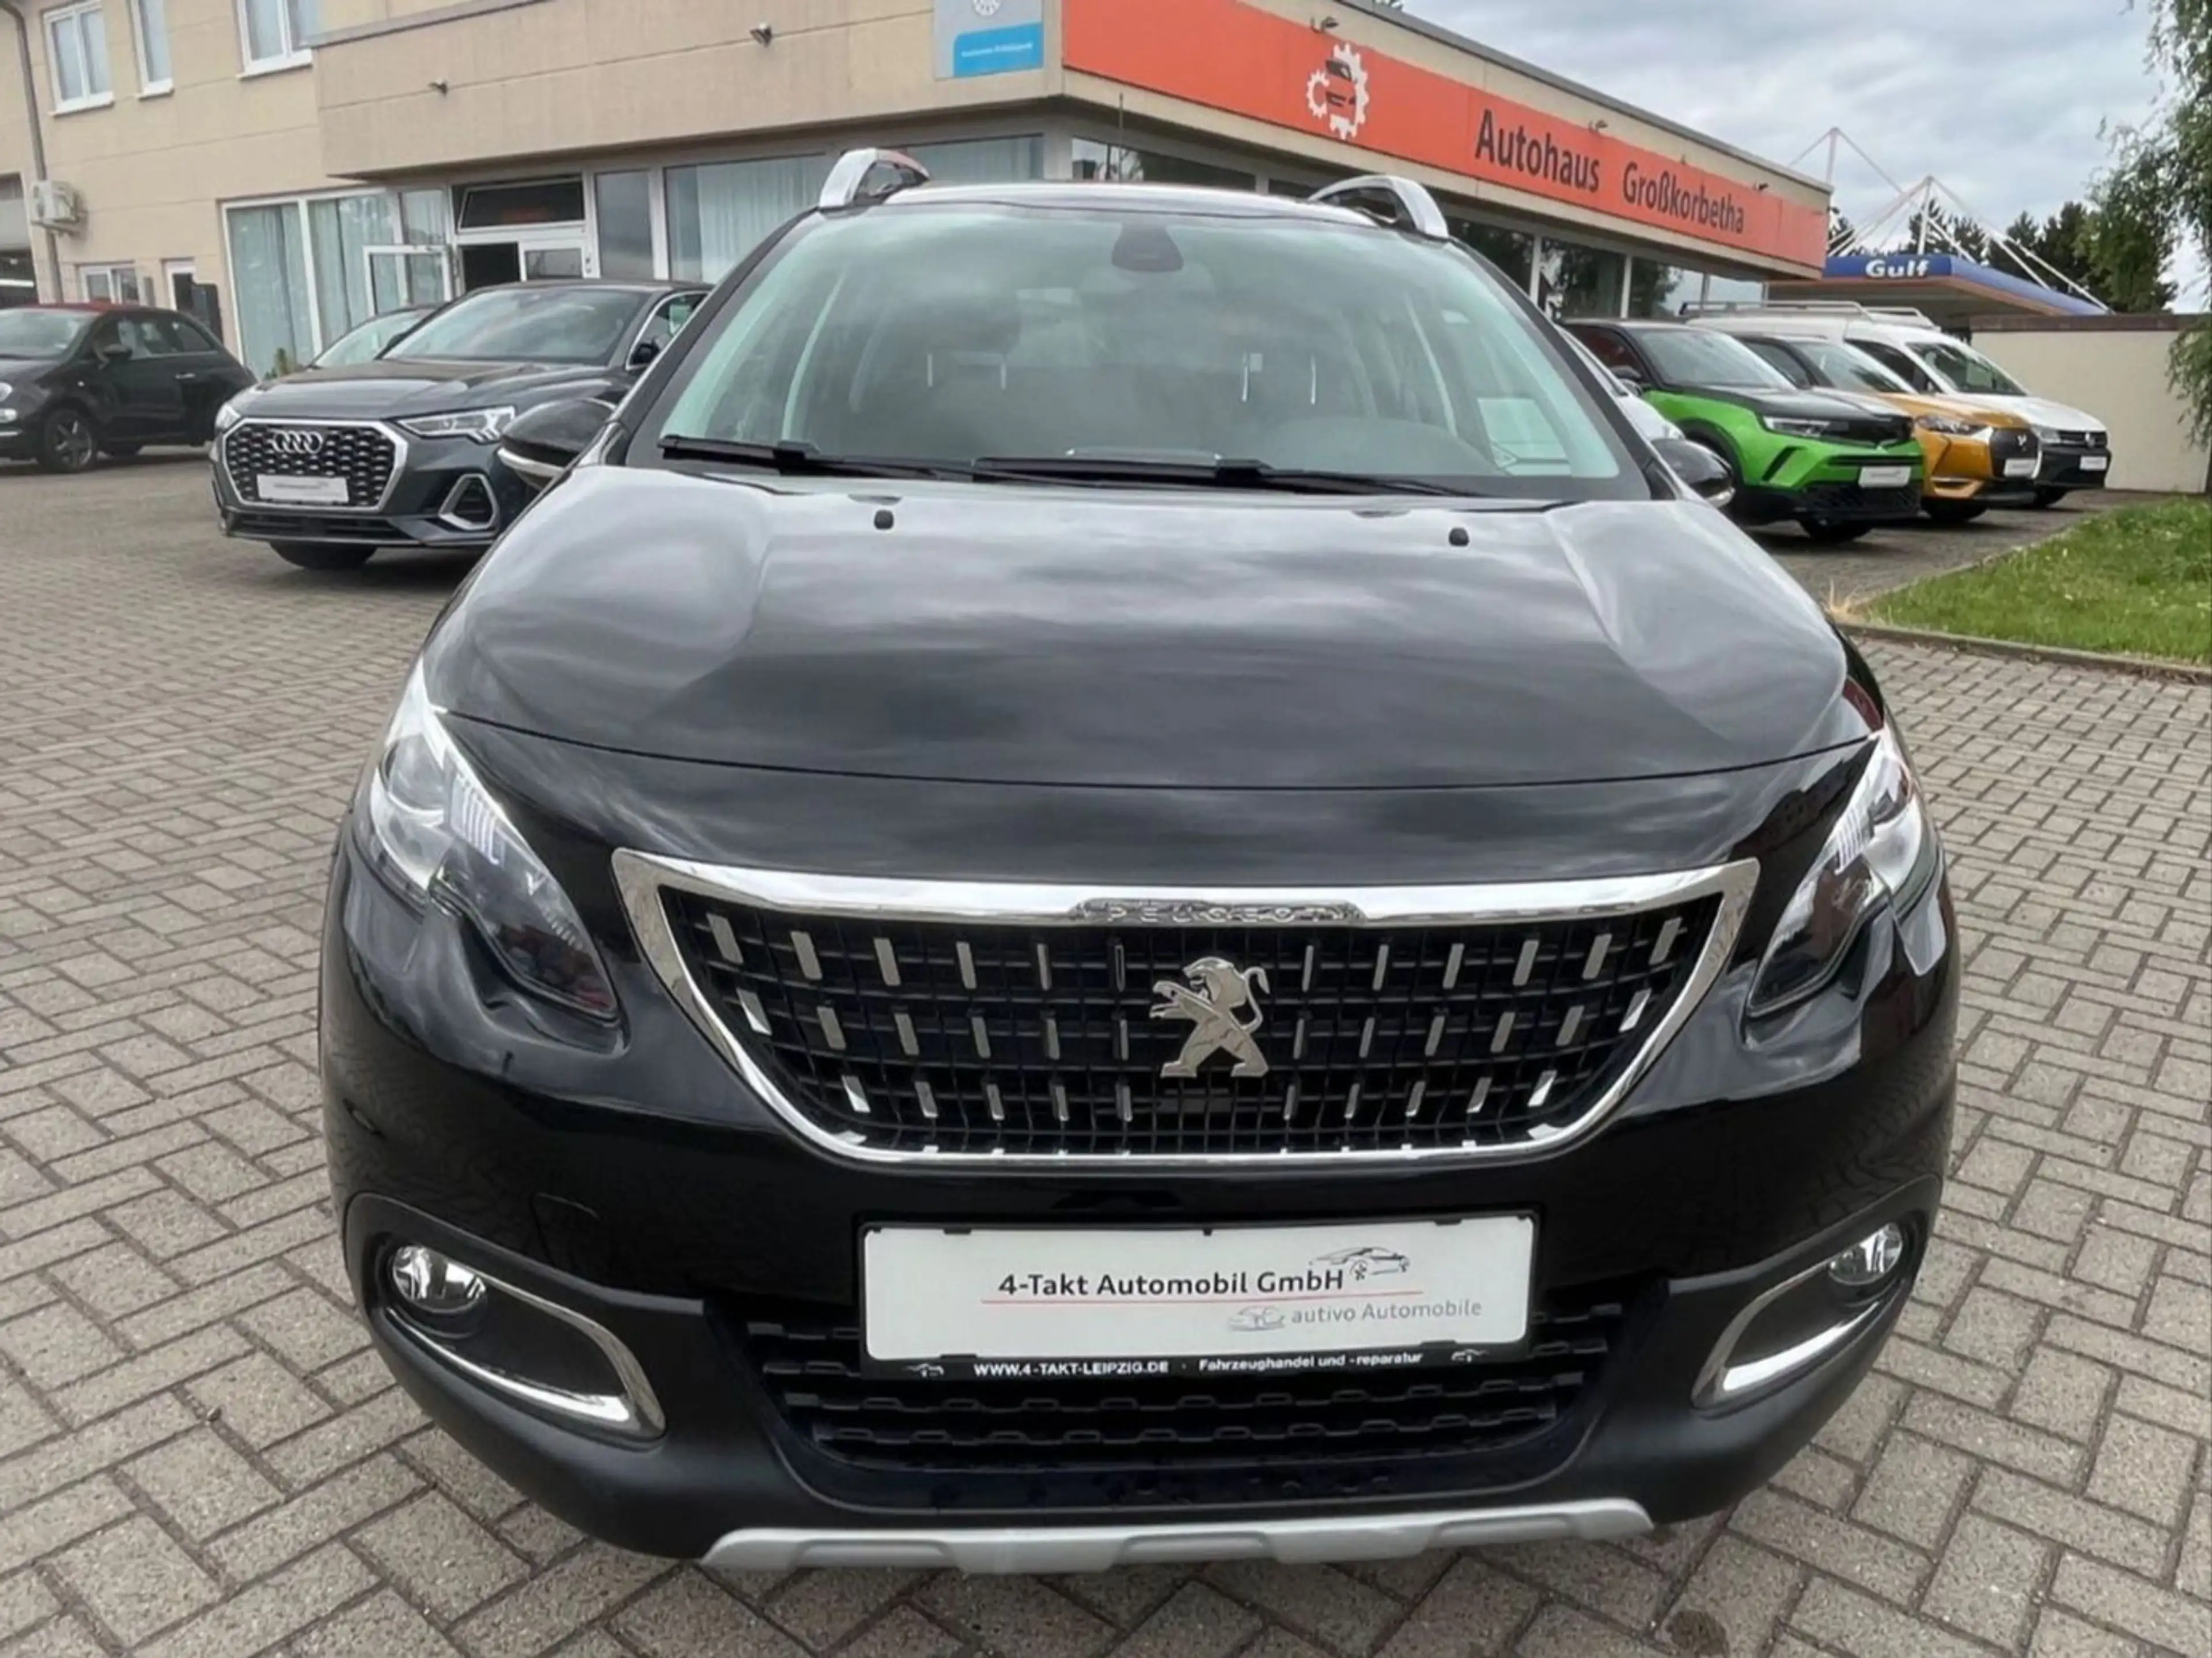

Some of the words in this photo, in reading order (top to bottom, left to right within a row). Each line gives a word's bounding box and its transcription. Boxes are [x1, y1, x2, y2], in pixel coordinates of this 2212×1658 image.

[1475, 108, 1600, 193] Autohaus
[1622, 161, 1744, 234] Großkorbetha
[1865, 259, 1929, 278] Gulf
[998, 1273, 1089, 1295] 4-Takt
[1096, 1271, 1248, 1295] Automobil
[1256, 1269, 1343, 1293] GmbH
[1291, 1304, 1357, 1324] autivo
[1361, 1298, 1483, 1320] Automobile
[1198, 1354, 1315, 1372] Fahrzeughandel
[1317, 1353, 1346, 1367] und
